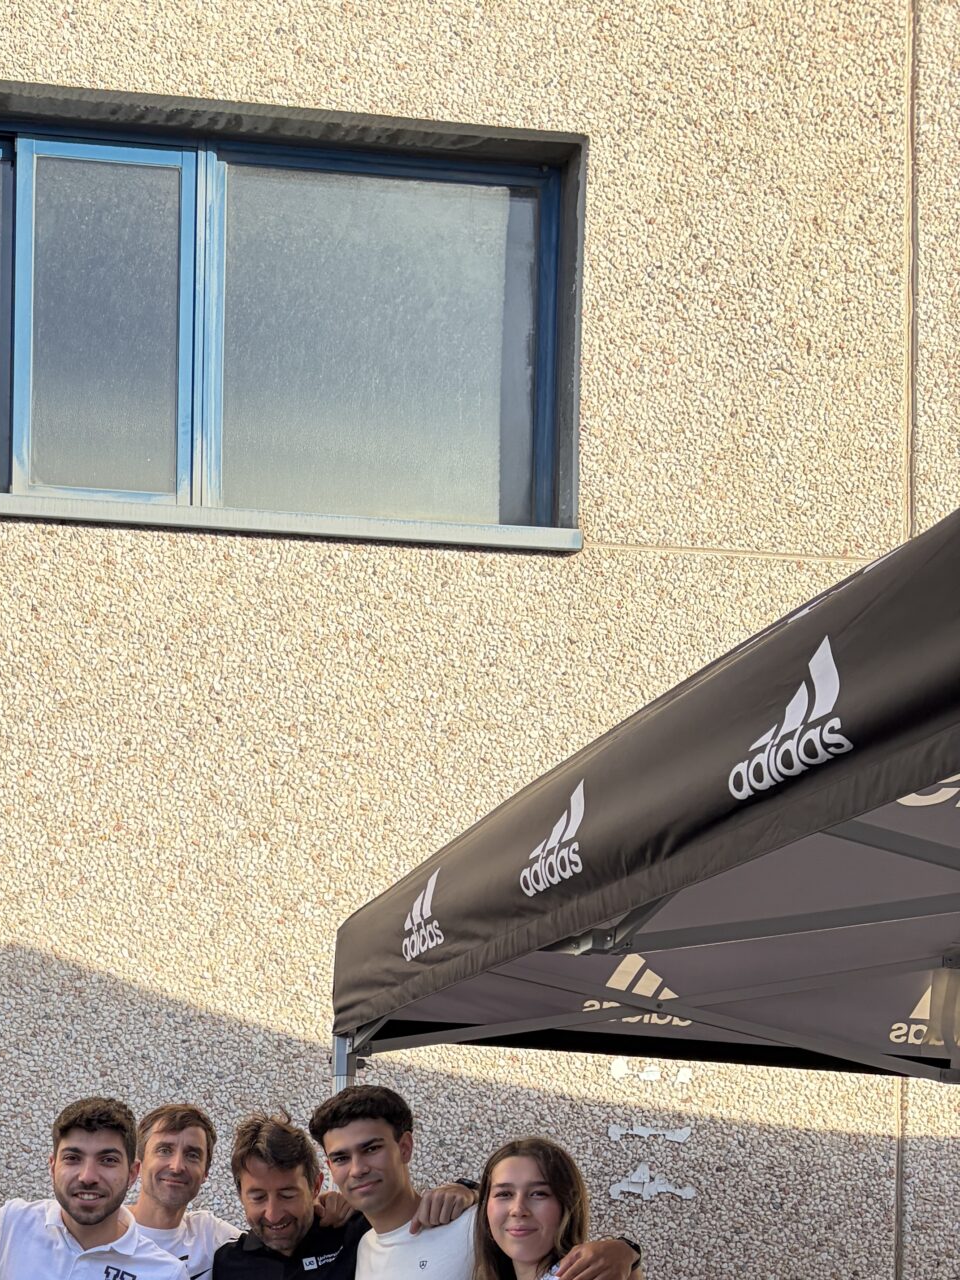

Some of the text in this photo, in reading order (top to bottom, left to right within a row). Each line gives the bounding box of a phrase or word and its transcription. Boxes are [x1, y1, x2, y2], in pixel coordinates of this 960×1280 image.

[728, 717, 854, 800] adidas
[519, 842, 583, 897] adidas
[402, 920, 445, 962] adidas
